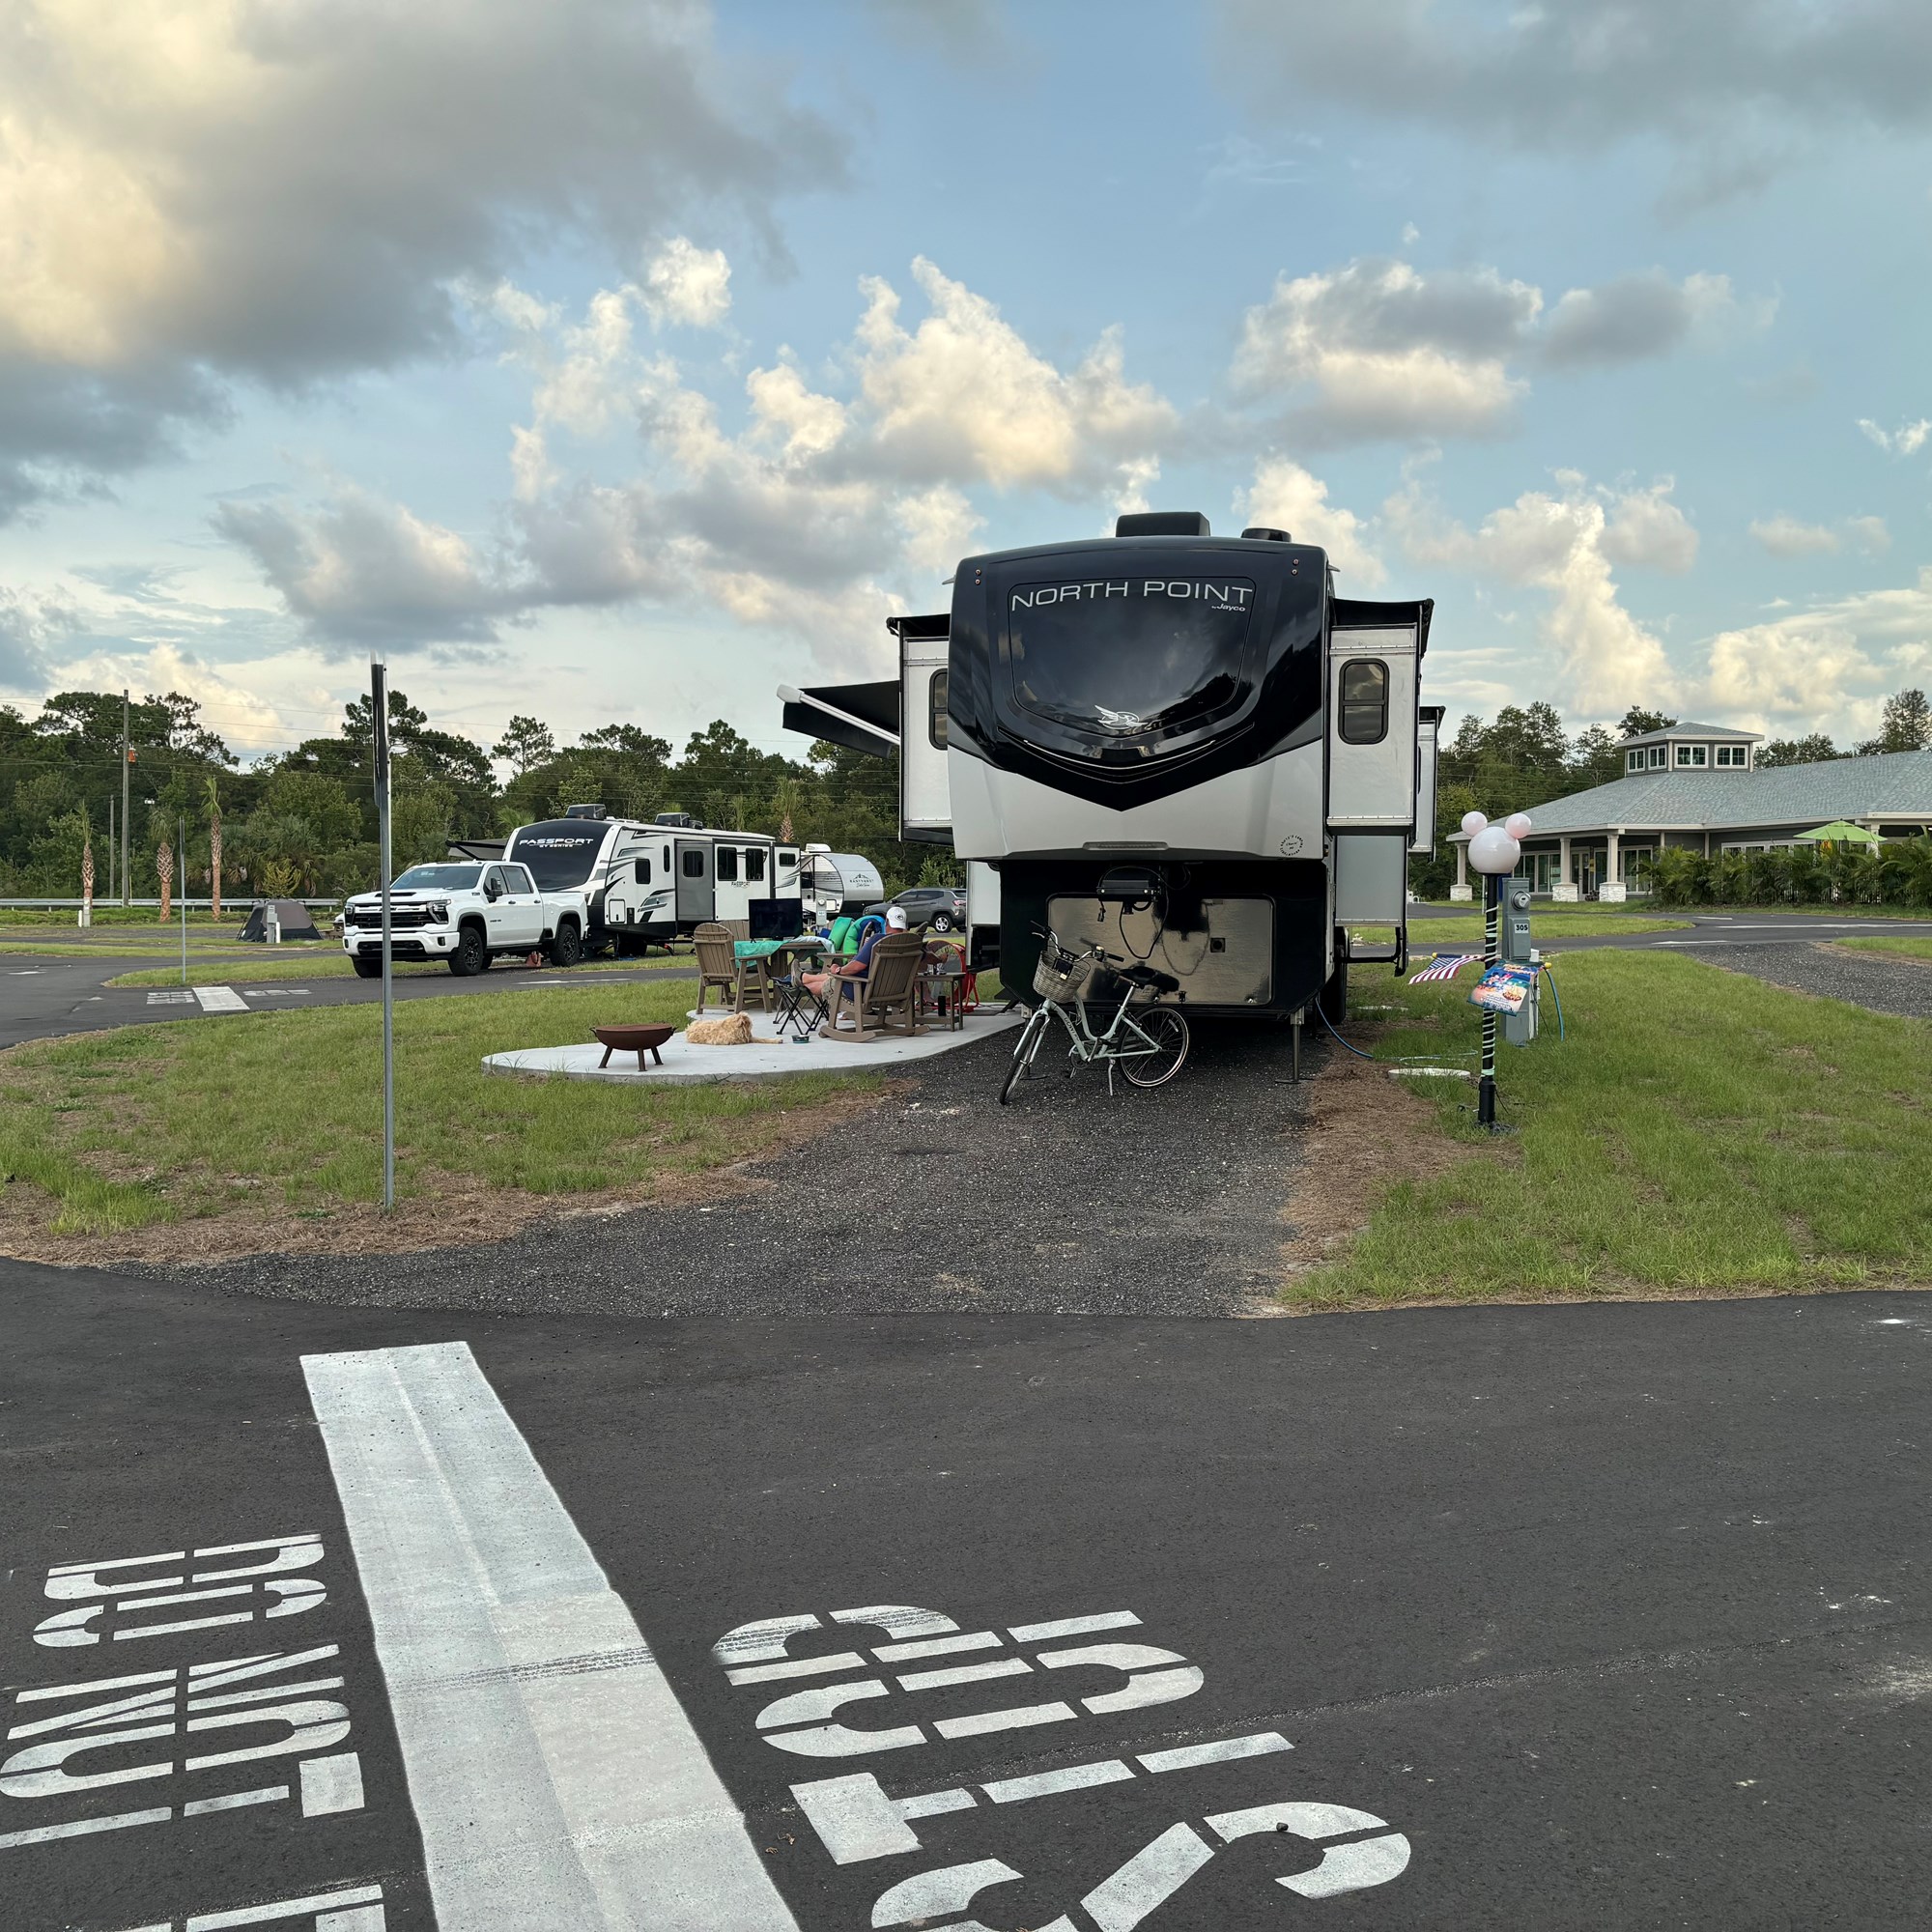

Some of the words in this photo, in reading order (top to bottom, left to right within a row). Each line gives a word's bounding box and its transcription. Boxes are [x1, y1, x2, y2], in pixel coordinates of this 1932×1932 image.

[1011, 582, 1128, 611] NORTH
[1144, 581, 1253, 604] POINT
[1217, 603, 1246, 611] Jayco
[713, 1604, 1411, 1932] STOP
